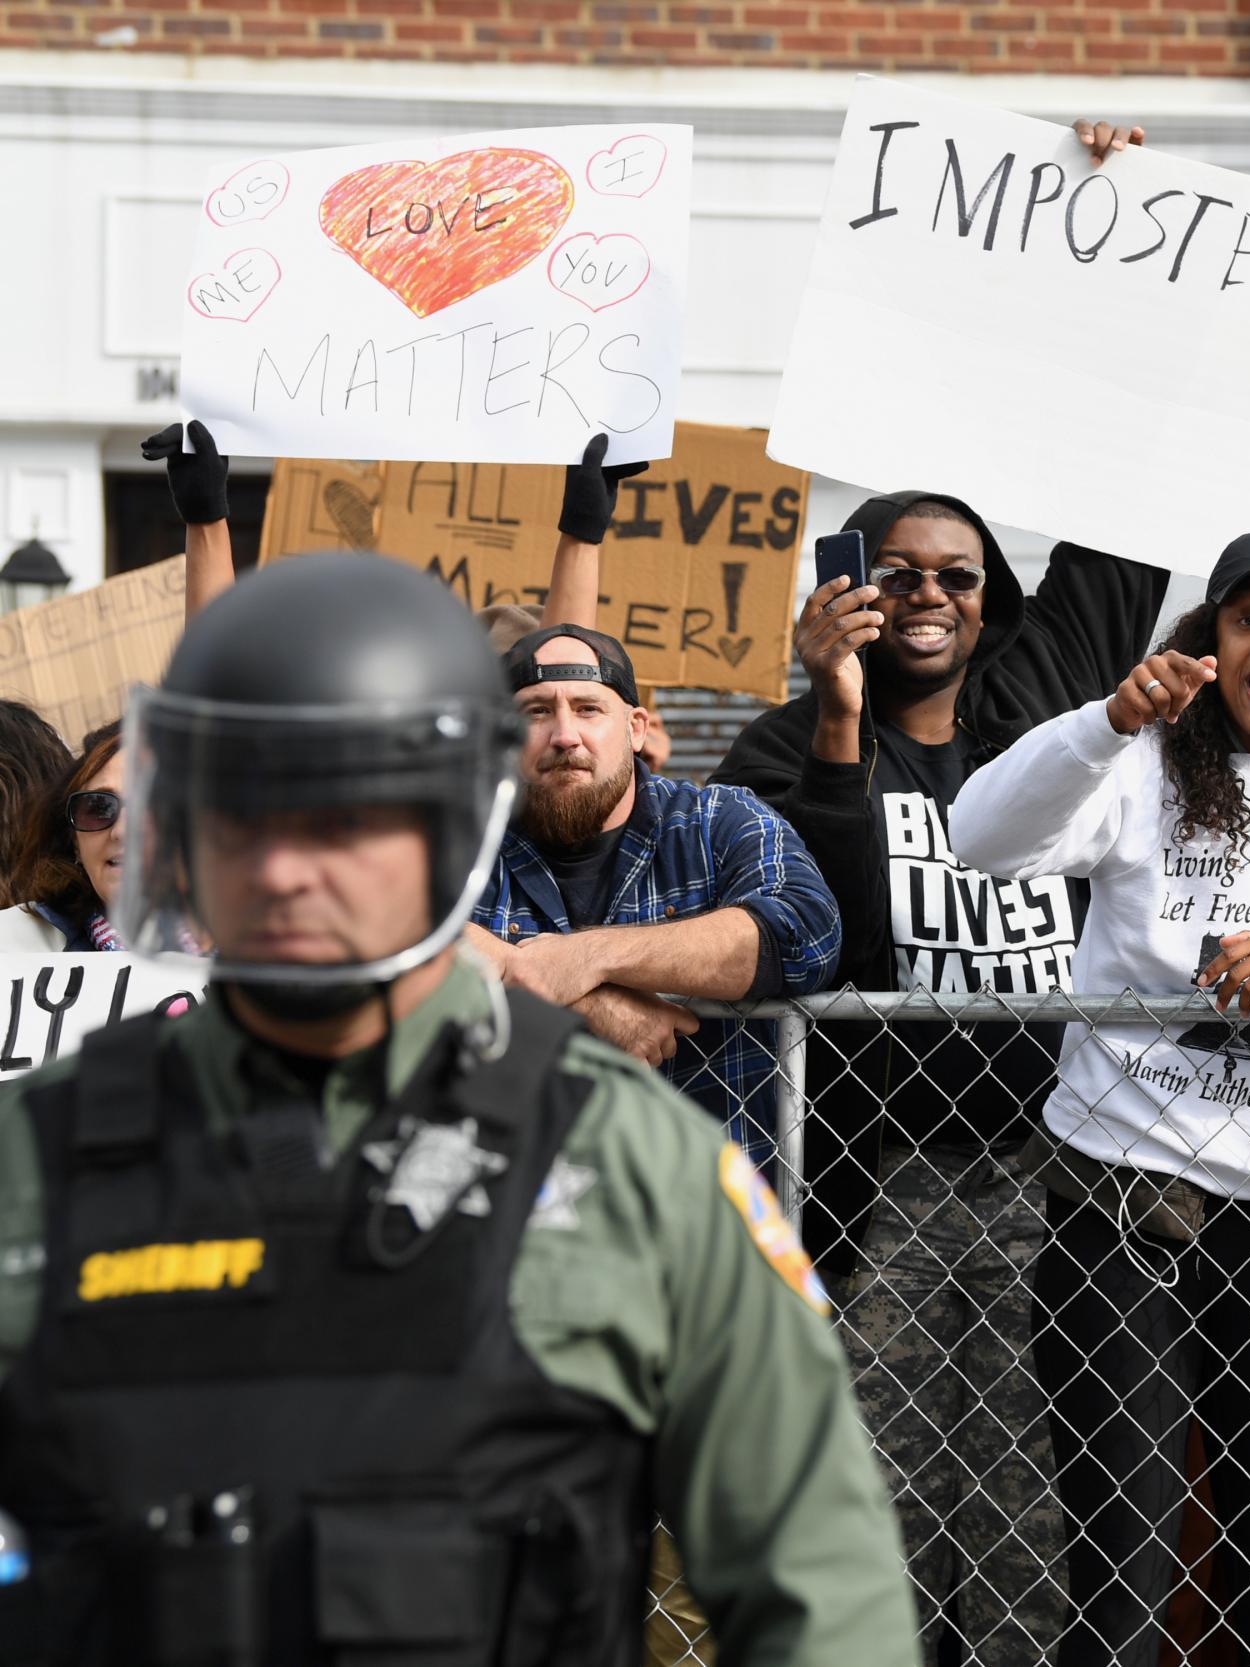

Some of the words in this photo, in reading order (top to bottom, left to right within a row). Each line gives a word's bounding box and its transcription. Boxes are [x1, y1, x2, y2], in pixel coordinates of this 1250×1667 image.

[603, 150, 645, 187] I
[218, 177, 278, 218] US
[367, 185, 514, 239] LOVE
[196, 259, 262, 313] ME
[253, 322, 662, 434] MATTERS
[407, 461, 522, 525] ALL
[608, 478, 801, 551] IVES
[1163, 847, 1237, 888] Living
[909, 864, 1058, 946] LIVES
[1159, 891, 1196, 922] Let
[1121, 1050, 1190, 1095] Martin
